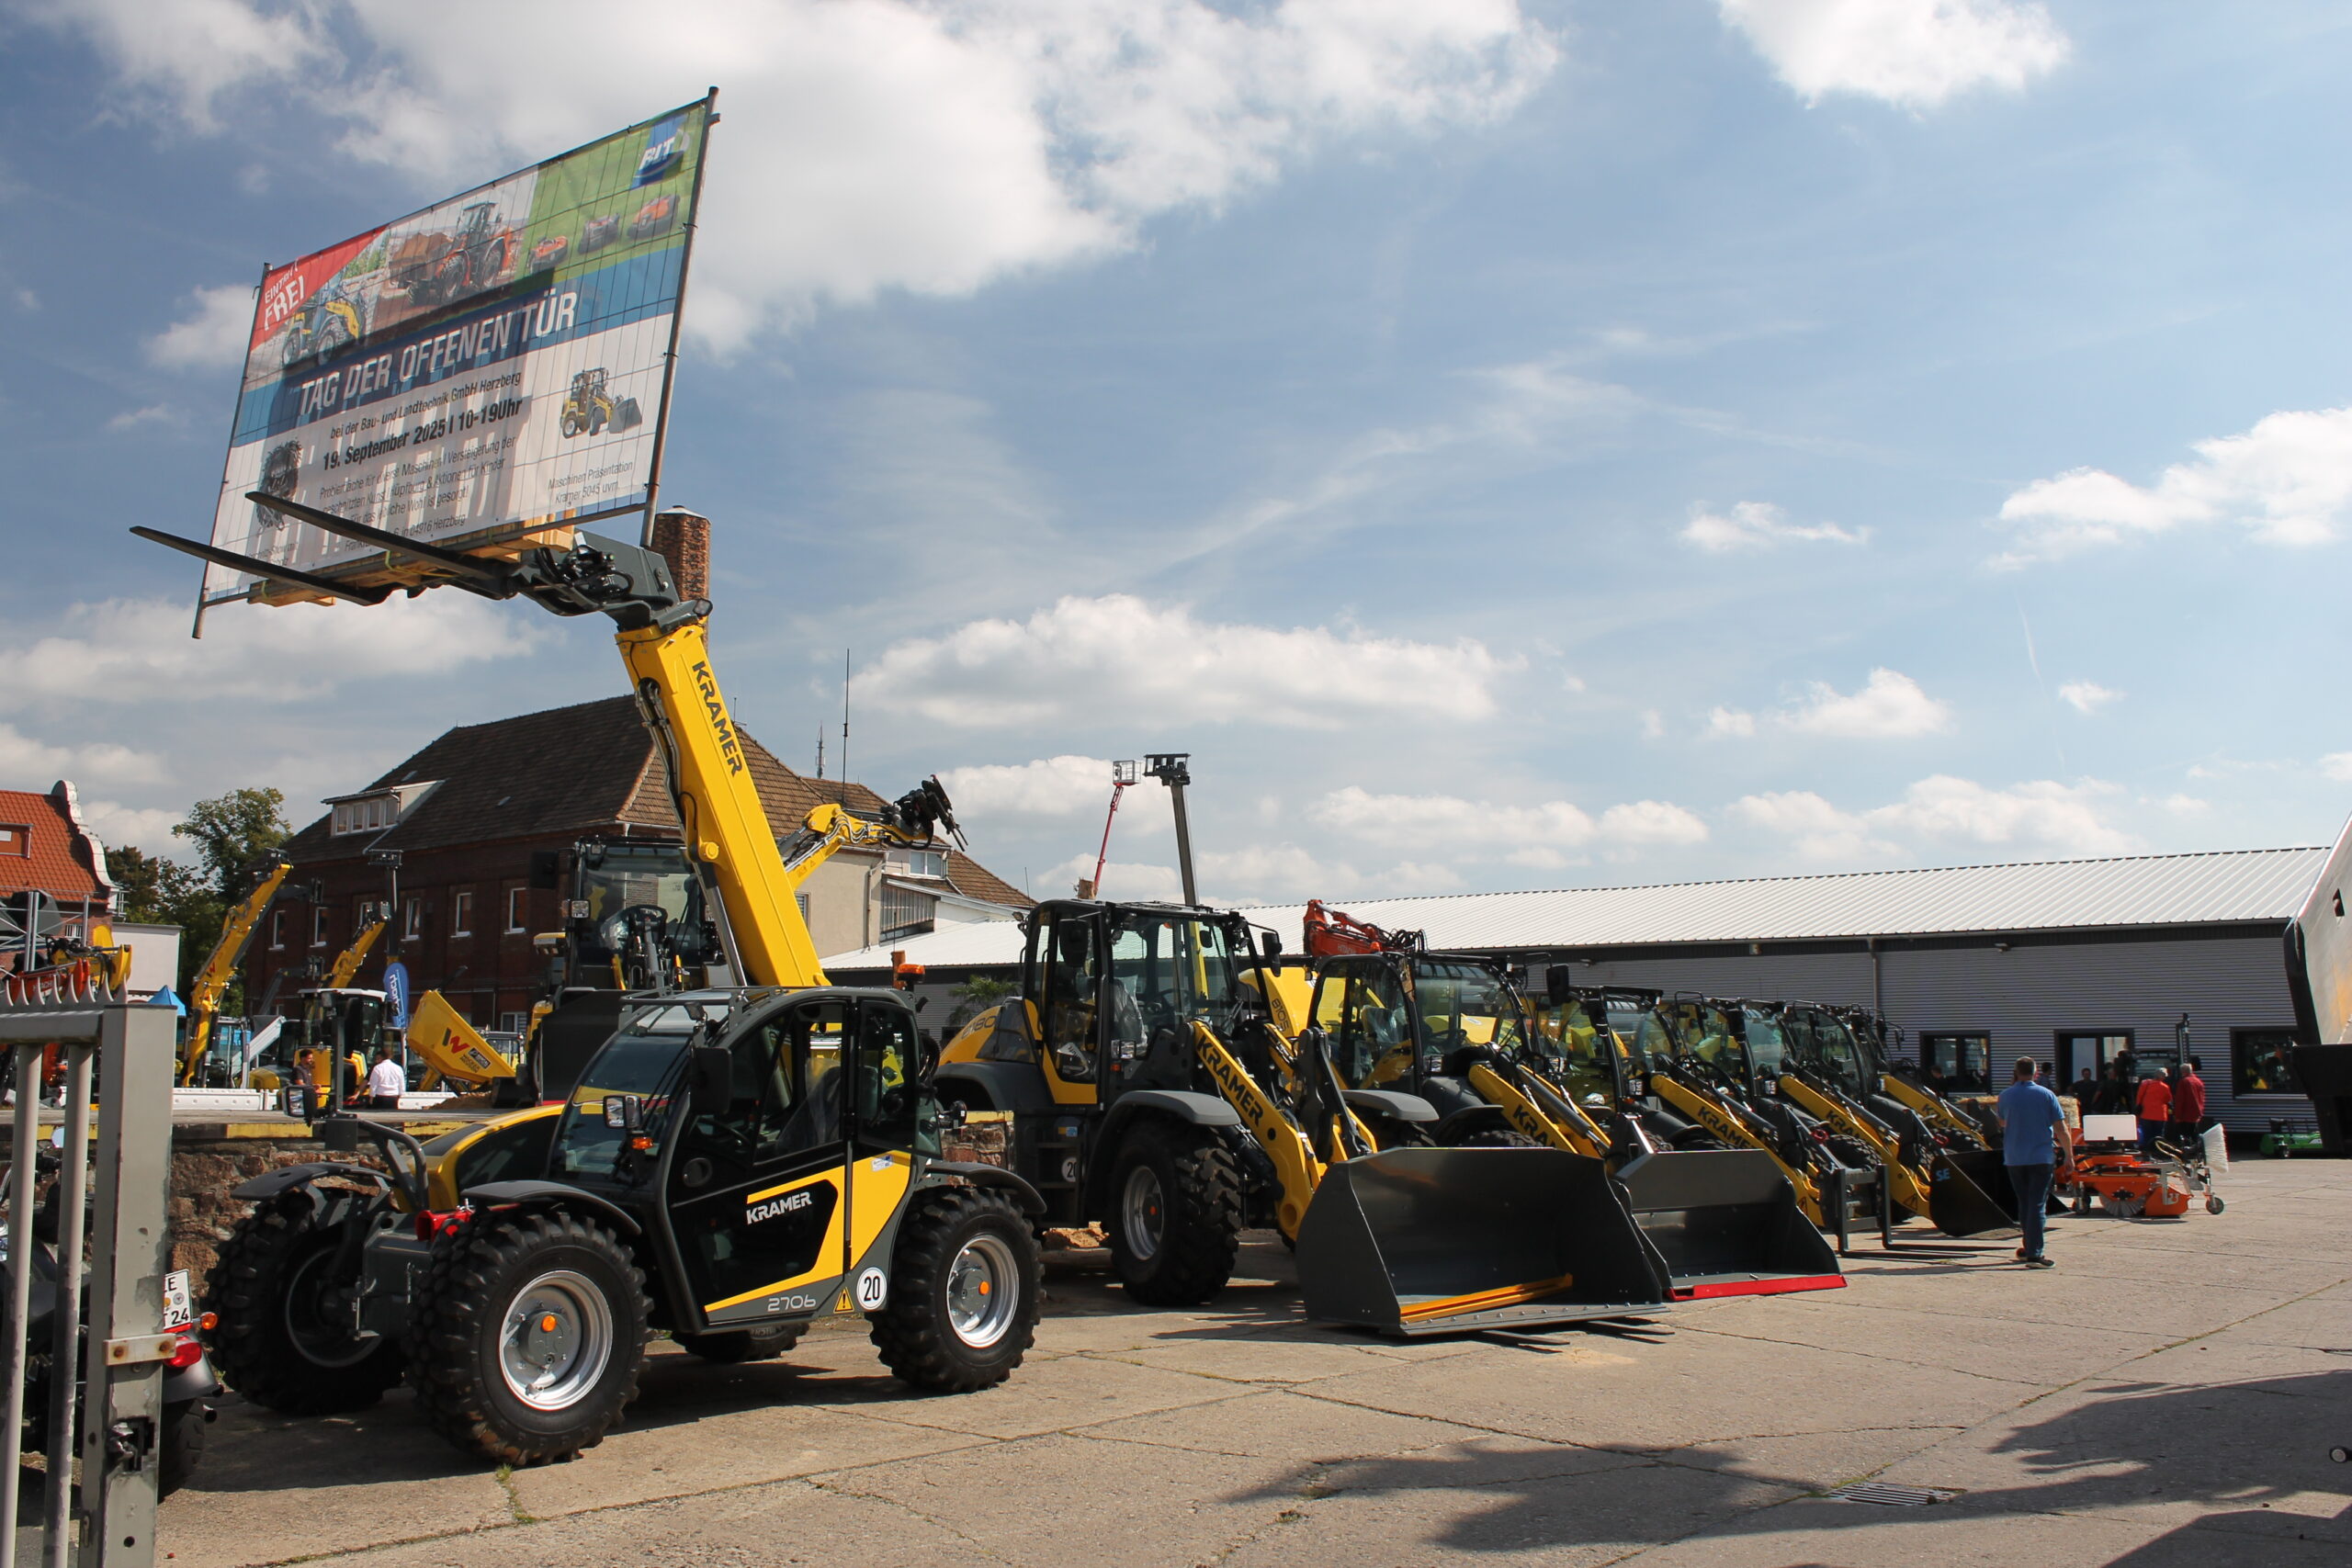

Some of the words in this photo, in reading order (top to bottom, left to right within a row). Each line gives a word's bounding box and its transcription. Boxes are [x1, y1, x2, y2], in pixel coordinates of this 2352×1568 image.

[264, 276, 305, 331] FREI
[300, 371, 339, 415] TAG
[344, 354, 392, 400] DER
[399, 310, 513, 383] OFFENEN
[521, 289, 578, 344] TÜR
[331, 426, 344, 439] bei
[345, 422, 359, 435] der
[360, 418, 379, 432] Bau-
[381, 410, 397, 424] und
[398, 393, 449, 419] Landtechnik
[451, 382, 478, 402] GmbH
[480, 372, 521, 393] Herzberg
[323, 452, 340, 470] 19.
[345, 432, 410, 465] September
[413, 419, 447, 445] 2025
[458, 399, 523, 431] 10-19Uhr
[502, 435, 516, 449] der
[548, 473, 586, 490] Maschinen
[588, 461, 633, 479] Präsentation
[556, 491, 582, 503] Kramer
[692, 660, 742, 777] KRAMER
[1197, 1035, 1264, 1126] KRAMER
[1513, 1103, 1555, 1147] KRA
[1936, 1168, 1951, 1181] SE
[746, 1191, 812, 1224] KRAMER
[767, 1295, 816, 1312] 2706
[864, 1276, 880, 1301] 20
